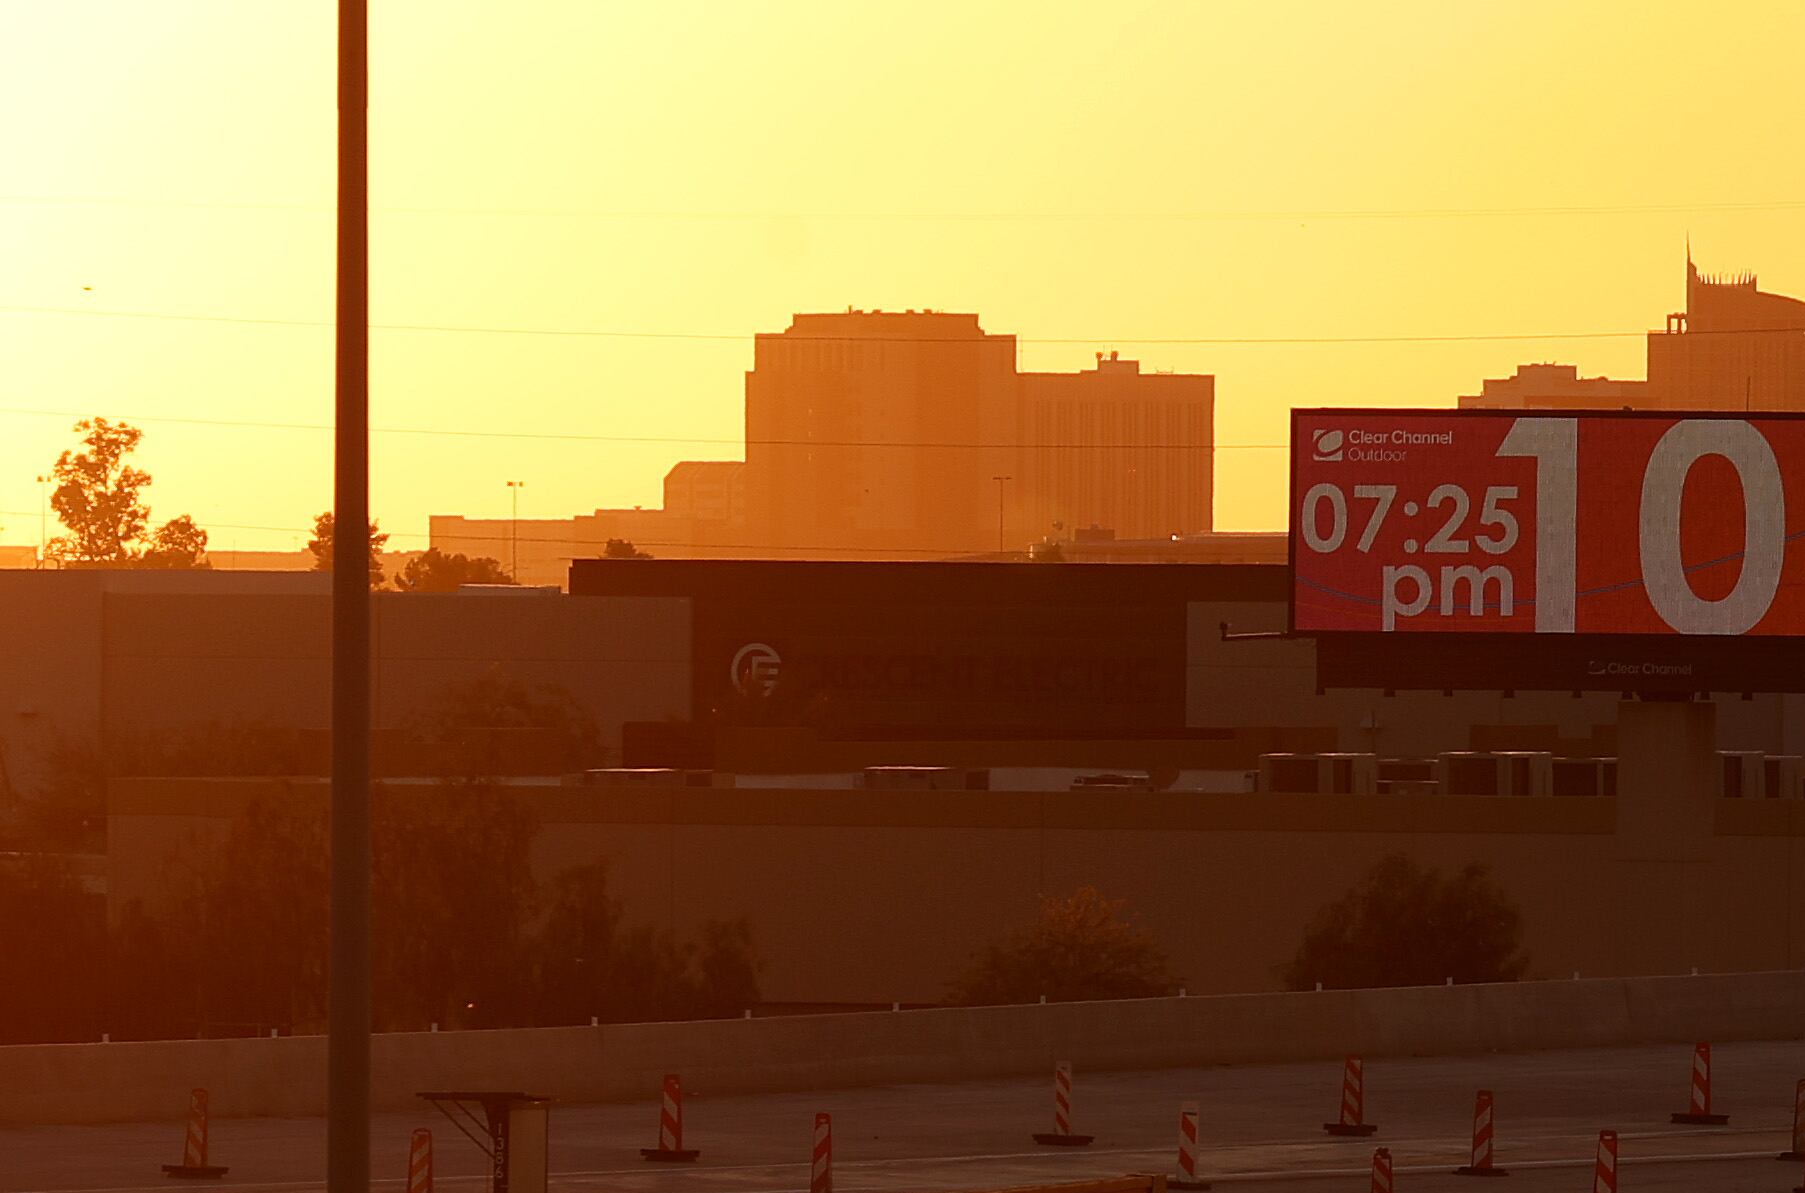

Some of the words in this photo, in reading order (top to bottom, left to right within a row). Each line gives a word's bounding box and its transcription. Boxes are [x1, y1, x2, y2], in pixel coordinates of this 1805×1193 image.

[1348, 429, 1389, 445] Clear
[1391, 430, 1453, 445] Channel
[1348, 447, 1407, 462] Outdoor
[1301, 482, 1520, 555] 07:25
[1381, 563, 1515, 632] pm
[1607, 661, 1641, 675] Clear
[1642, 662, 1693, 676] Channel
